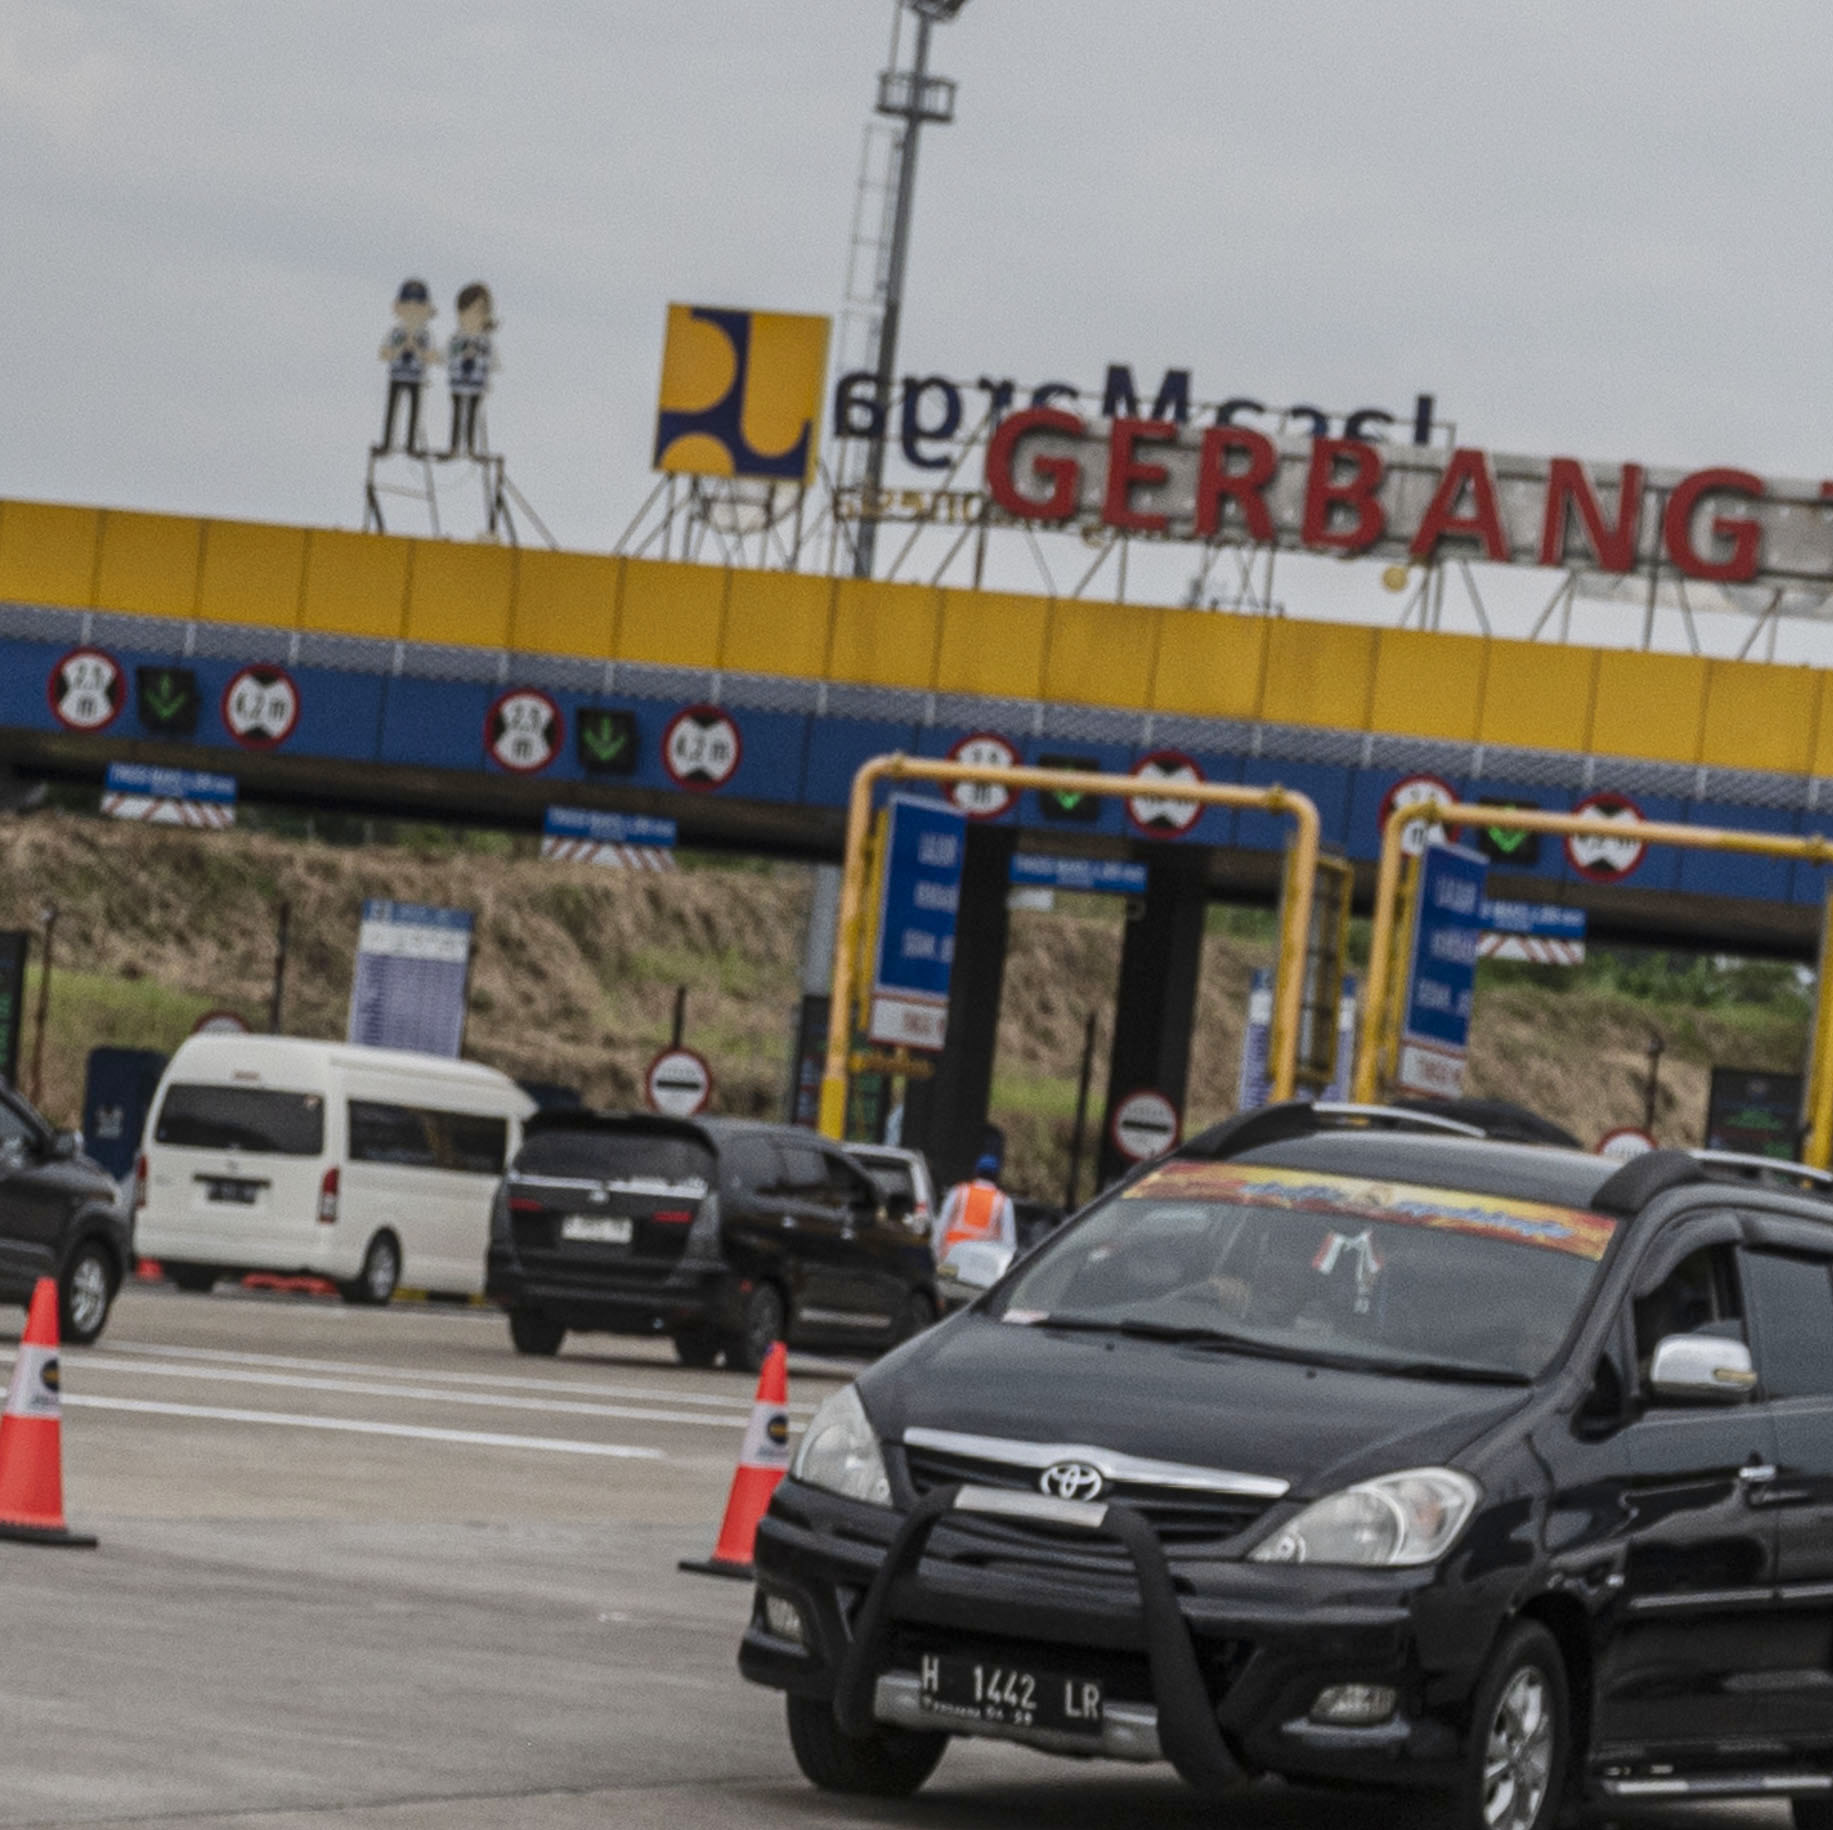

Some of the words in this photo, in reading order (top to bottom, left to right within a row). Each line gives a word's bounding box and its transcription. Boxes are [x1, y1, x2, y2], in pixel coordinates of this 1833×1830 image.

[984, 407, 1768, 582] GERBANG
[921, 1654, 940, 1693] H
[973, 1664, 1038, 1711] 1442
[1065, 1680, 1100, 1720] LR
